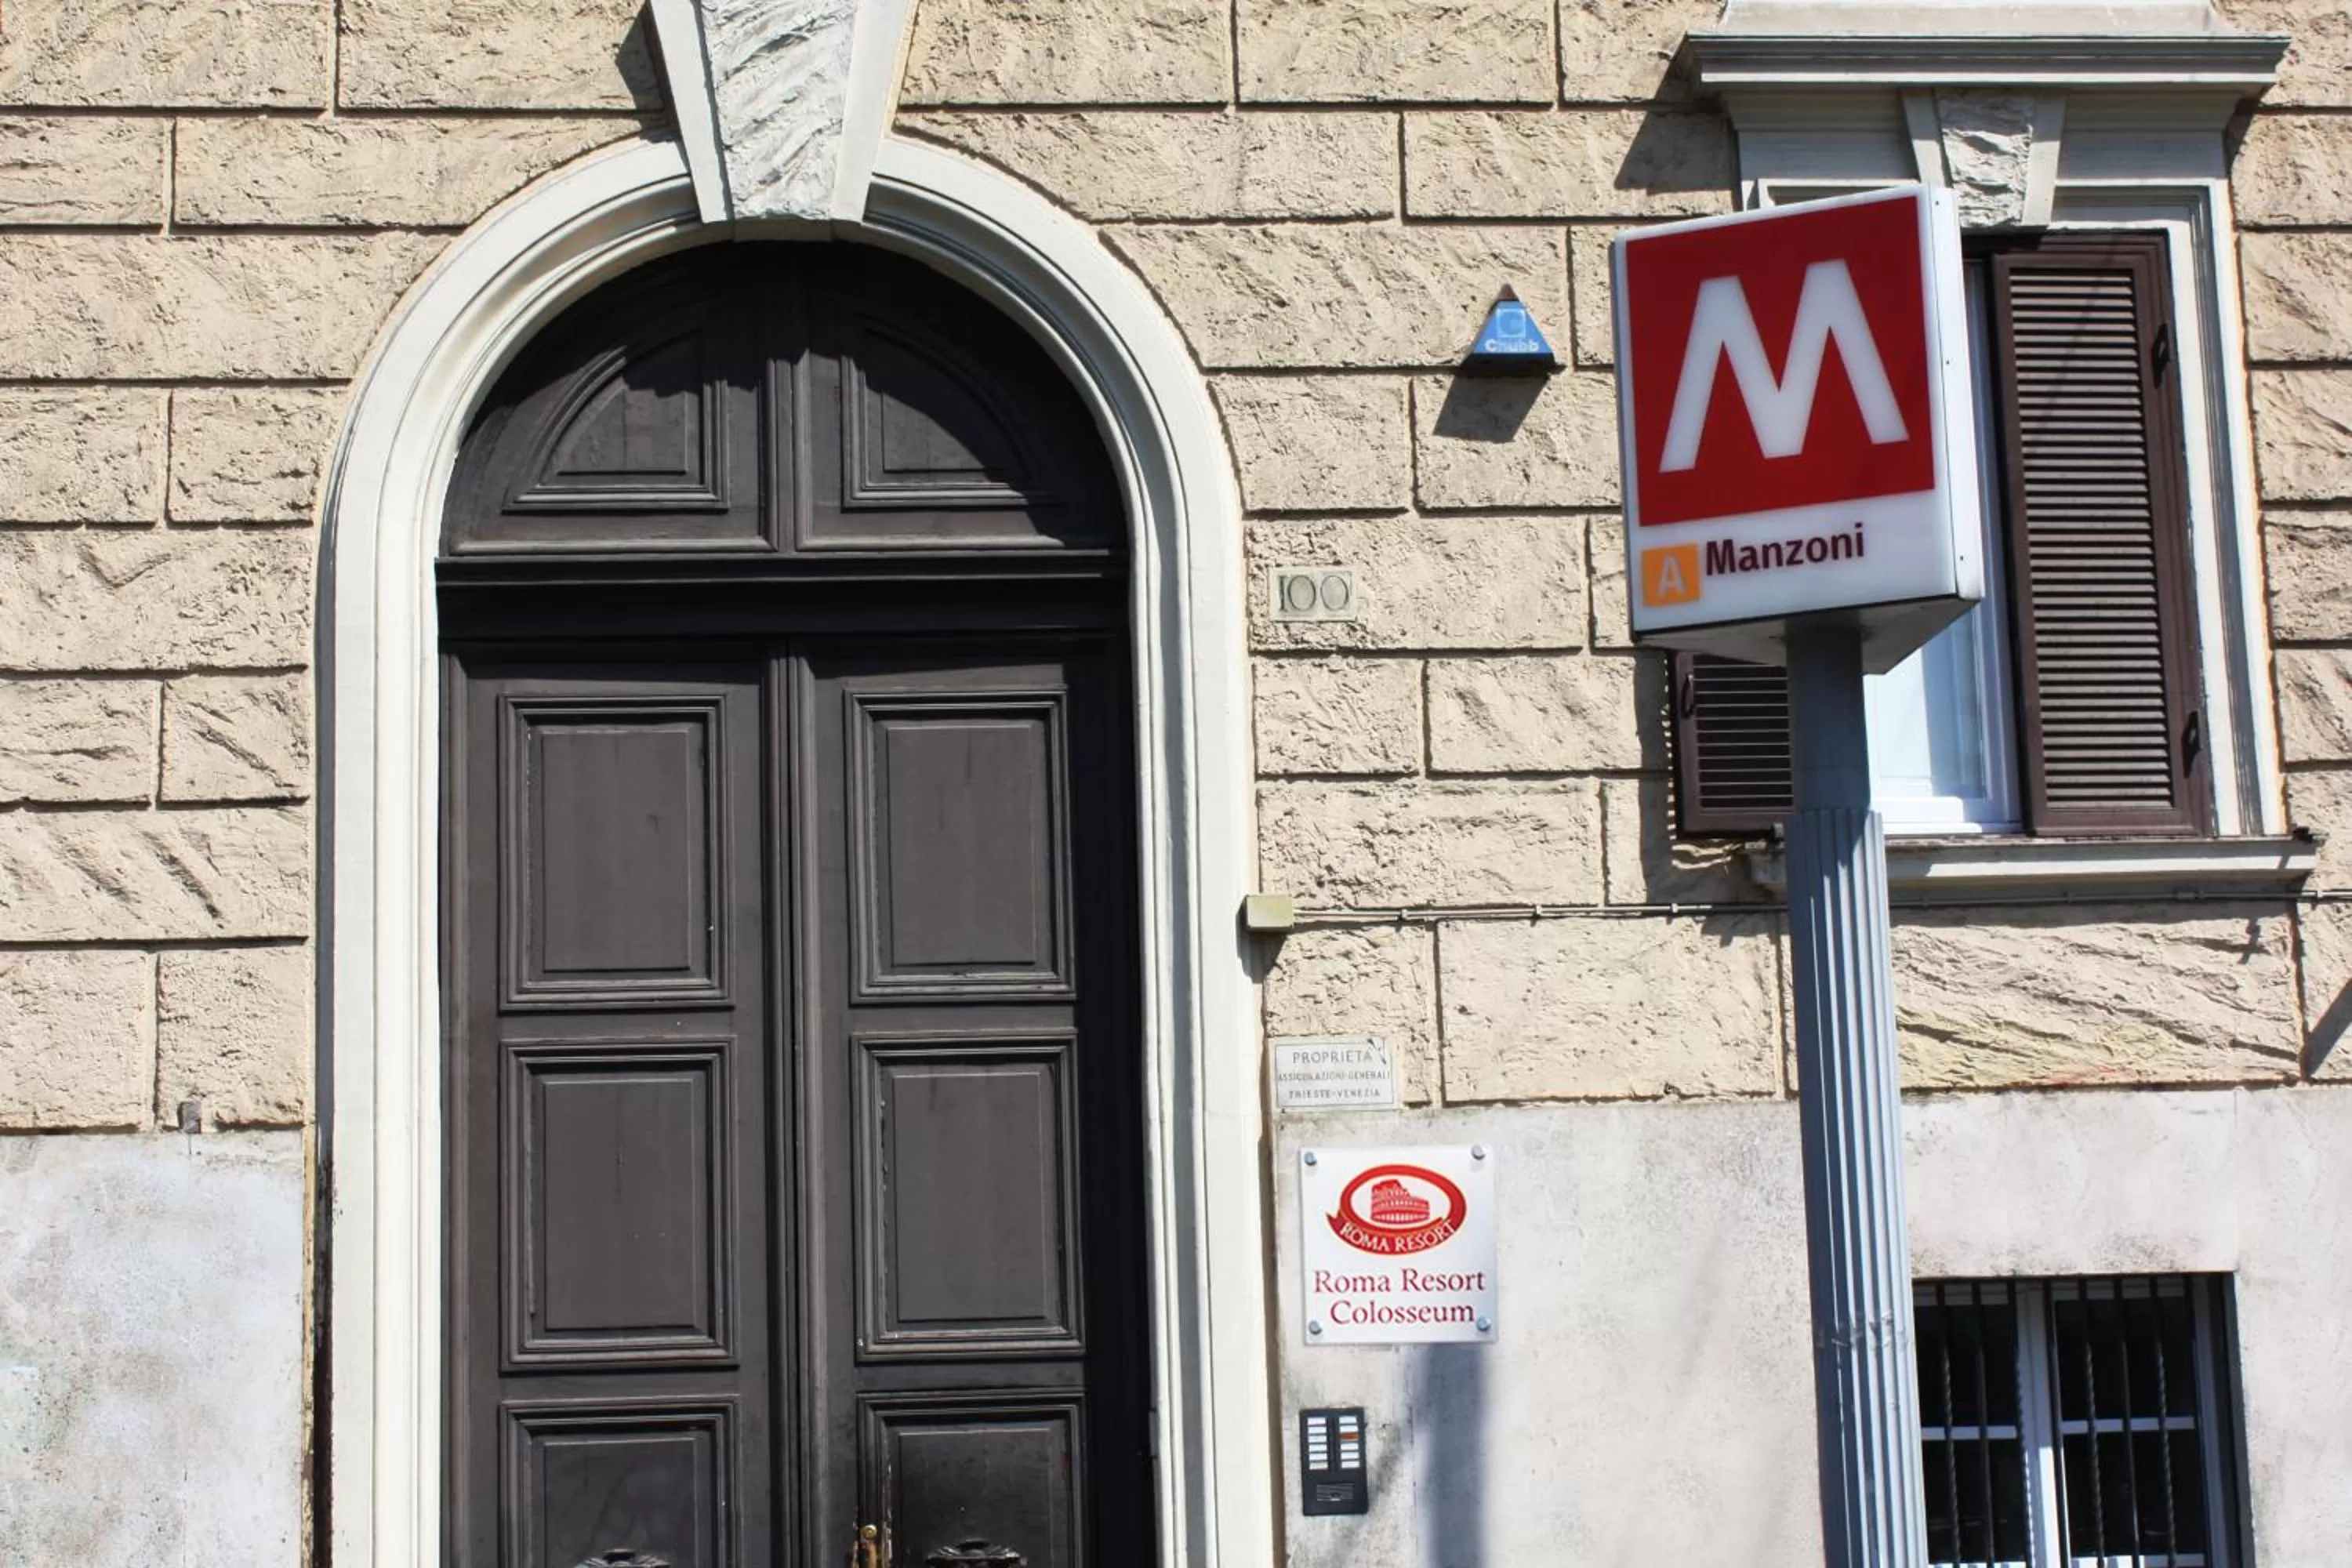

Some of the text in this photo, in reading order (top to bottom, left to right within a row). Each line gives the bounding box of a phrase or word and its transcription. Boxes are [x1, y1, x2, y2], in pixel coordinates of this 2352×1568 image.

[1658, 258, 1910, 474] M
[1655, 523, 1865, 600] A Manzoni
[1339, 1221, 1457, 1252] ROMA RESORT
[1314, 1268, 1486, 1293] Roma Resort
[1330, 1300, 1475, 1325] Colosseum
